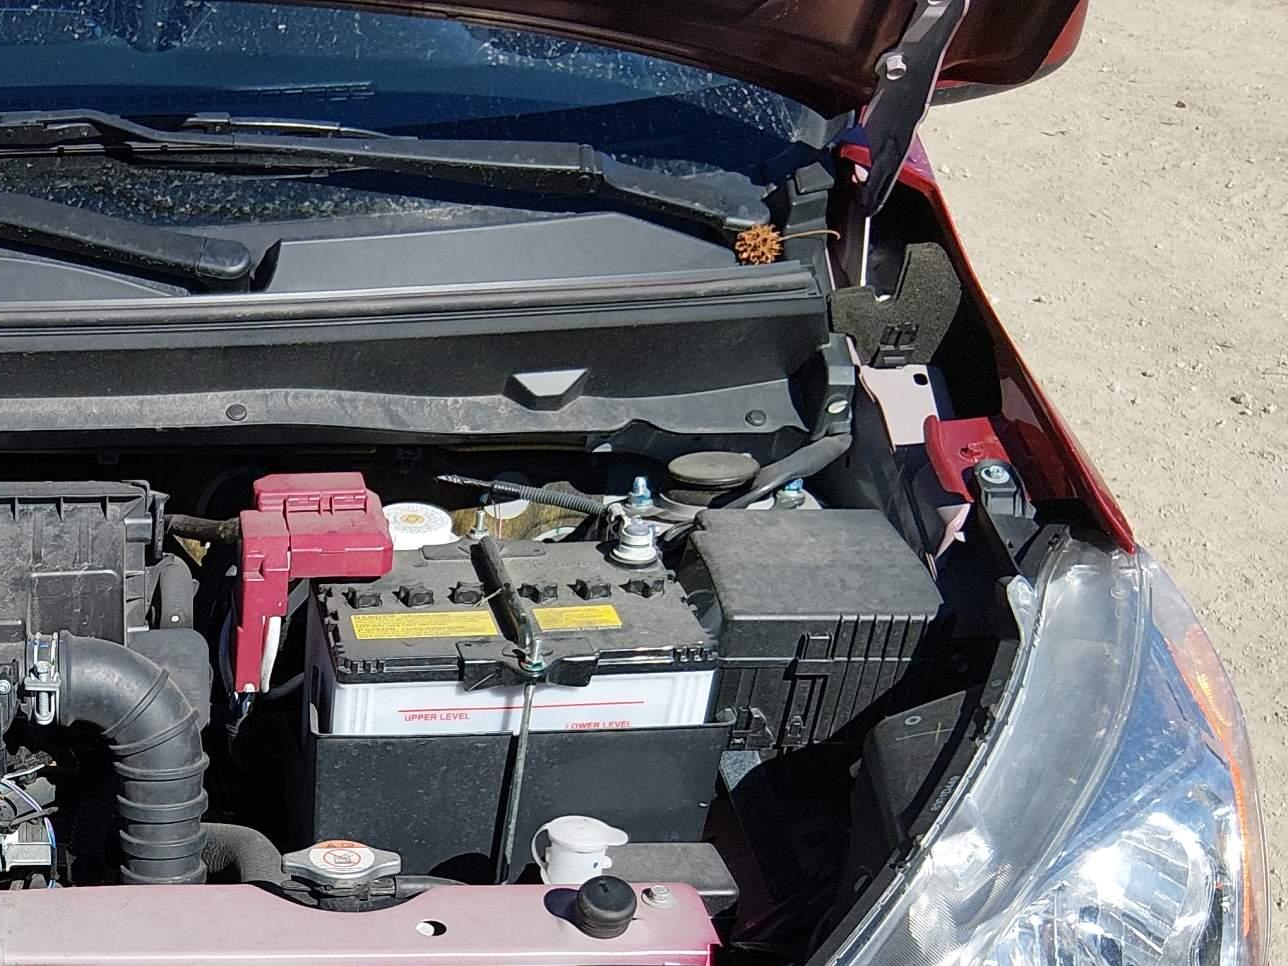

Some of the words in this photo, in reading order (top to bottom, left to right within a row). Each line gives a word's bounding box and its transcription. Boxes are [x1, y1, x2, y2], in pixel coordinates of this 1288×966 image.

[404, 713, 437, 722] UPPER
[439, 712, 471, 721] LEVEL
[602, 720, 633, 729] LEVEL
